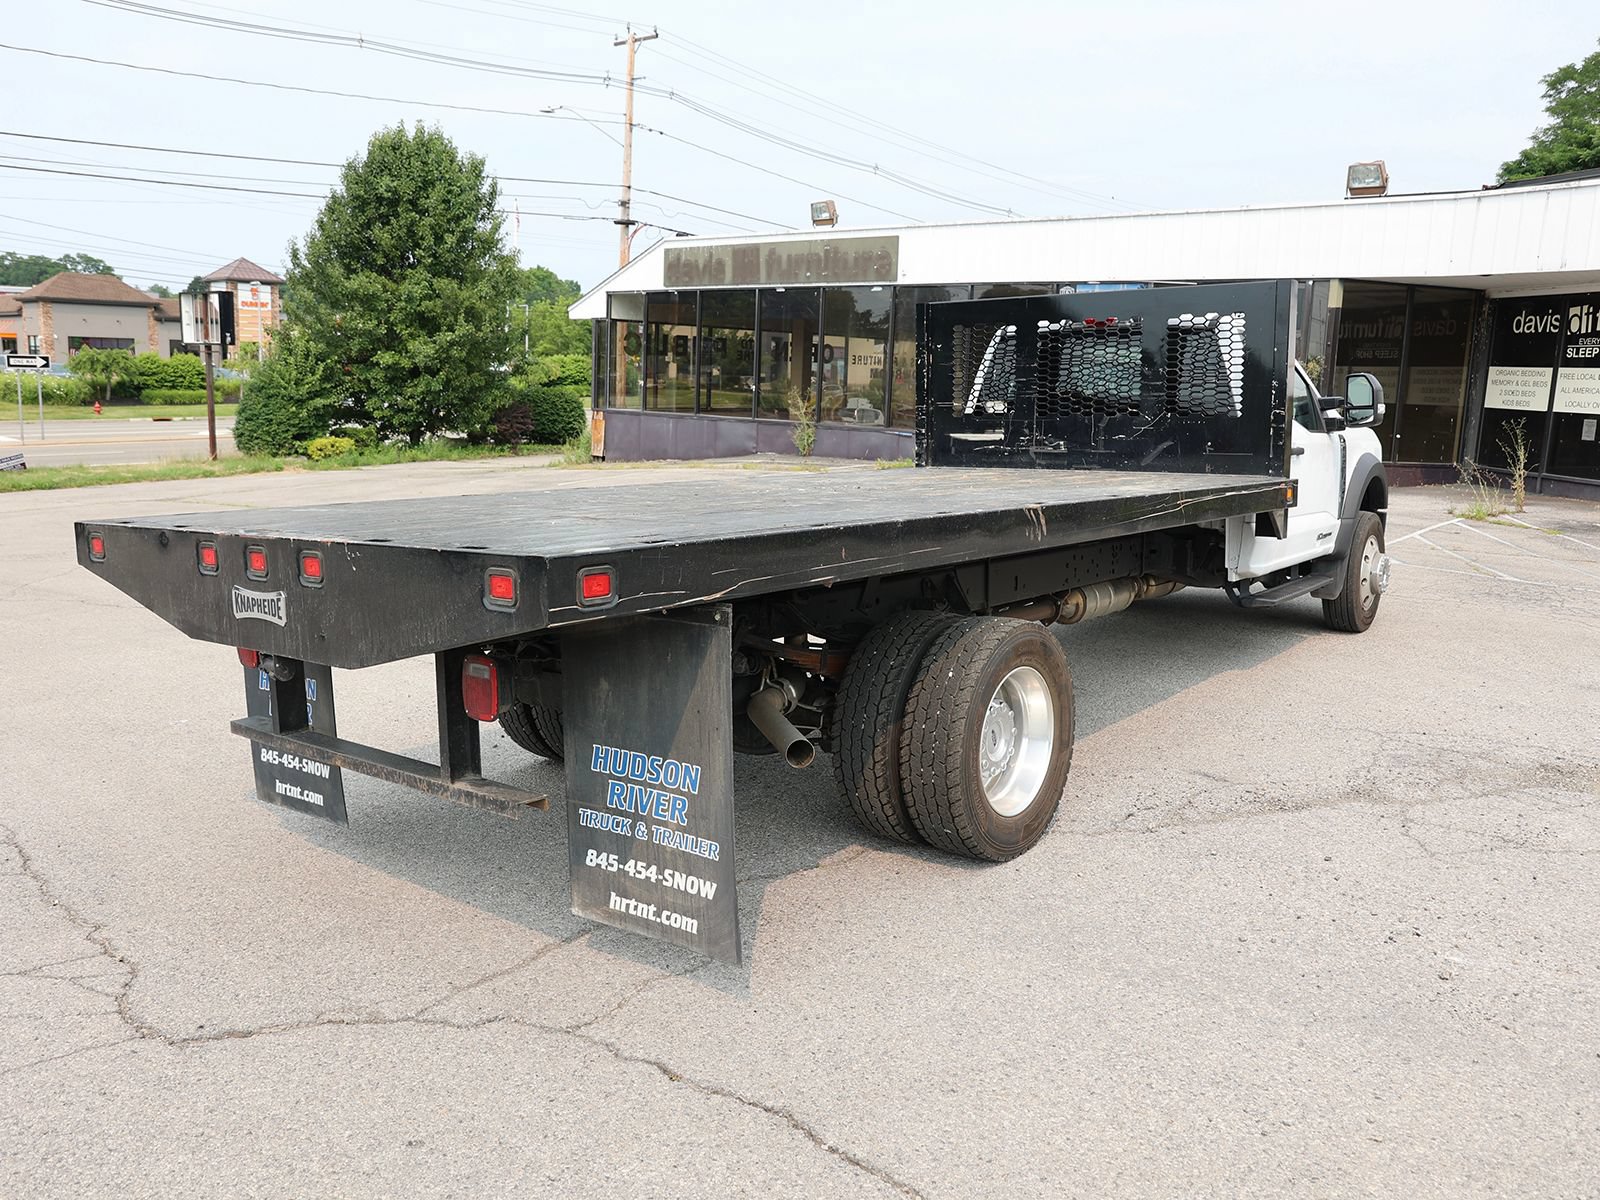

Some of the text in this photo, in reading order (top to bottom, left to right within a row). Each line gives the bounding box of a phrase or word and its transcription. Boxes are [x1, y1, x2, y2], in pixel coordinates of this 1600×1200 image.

[1512, 309, 1561, 334] davis
[1566, 348, 1600, 358] SLEEP
[1495, 369, 1520, 377] ORGANIC
[234, 591, 283, 621] KNAPHEIDE
[260, 748, 330, 779] 845-454-SNOW
[591, 744, 701, 794] HUDSON
[275, 779, 324, 806] hrtnt.com
[607, 779, 688, 825] RIVER
[579, 808, 720, 861] TRUCK & TRAILER
[585, 849, 718, 900] 845-454-SNOW
[609, 891, 698, 934] hrtnt.com
